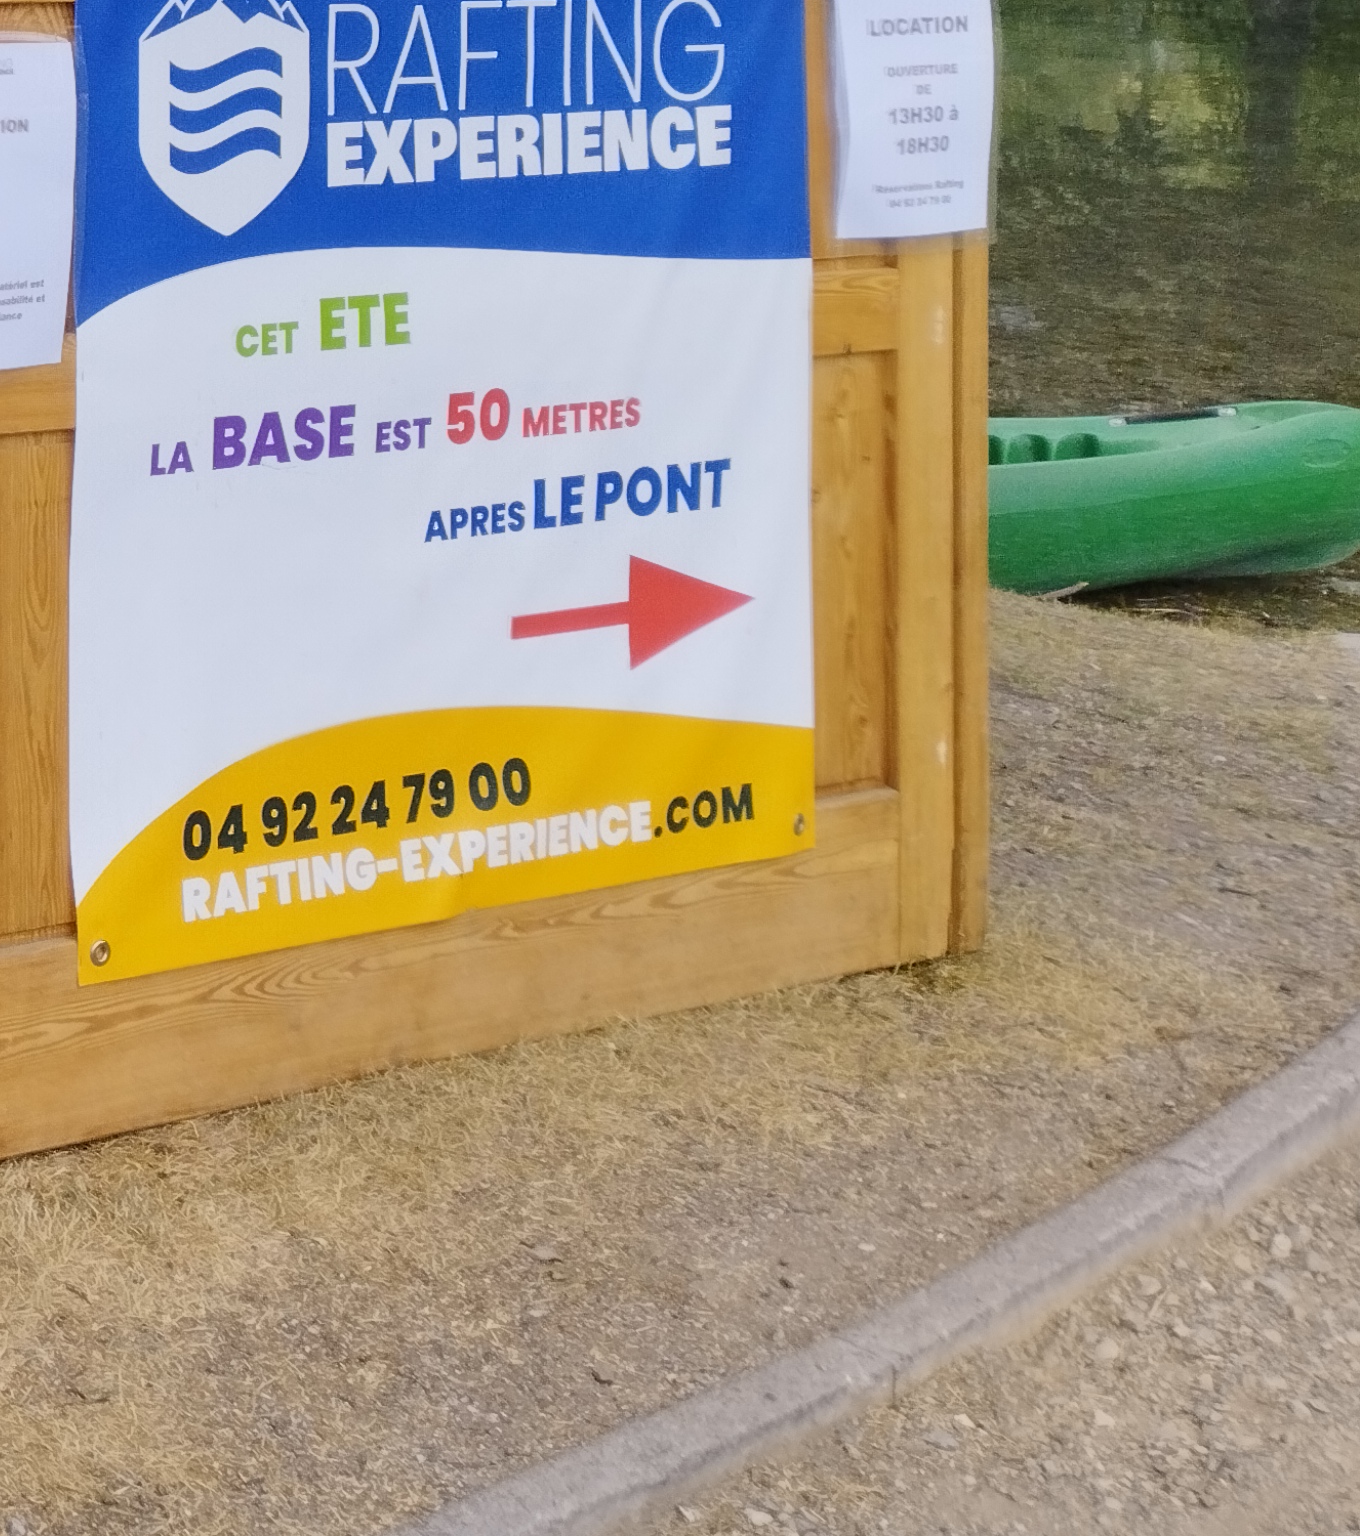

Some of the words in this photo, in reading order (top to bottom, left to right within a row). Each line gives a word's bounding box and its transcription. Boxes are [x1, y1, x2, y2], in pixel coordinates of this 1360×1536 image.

[868, 16, 968, 37] LOCATION
[886, 63, 958, 78] OUVERTURE
[327, 104, 732, 188] EXPERIENCE
[888, 106, 944, 125] 13H30
[897, 135, 950, 155] 18H30
[235, 322, 299, 358] CET
[320, 293, 410, 351] ETE
[150, 441, 193, 476] LA
[212, 404, 357, 473] BASE
[375, 417, 431, 454] EST
[446, 388, 511, 445] 50
[522, 397, 640, 441] METRES
[424, 501, 526, 544] APRES
[532, 474, 586, 532] LE
[593, 459, 732, 523] PONT
[183, 804, 248, 860] 04
[261, 791, 318, 847] 92
[331, 780, 390, 835] 24
[402, 769, 455, 823] 79
[469, 758, 531, 811] 00
[182, 783, 755, 923] RAFTING-EXPERIENCE.COM
